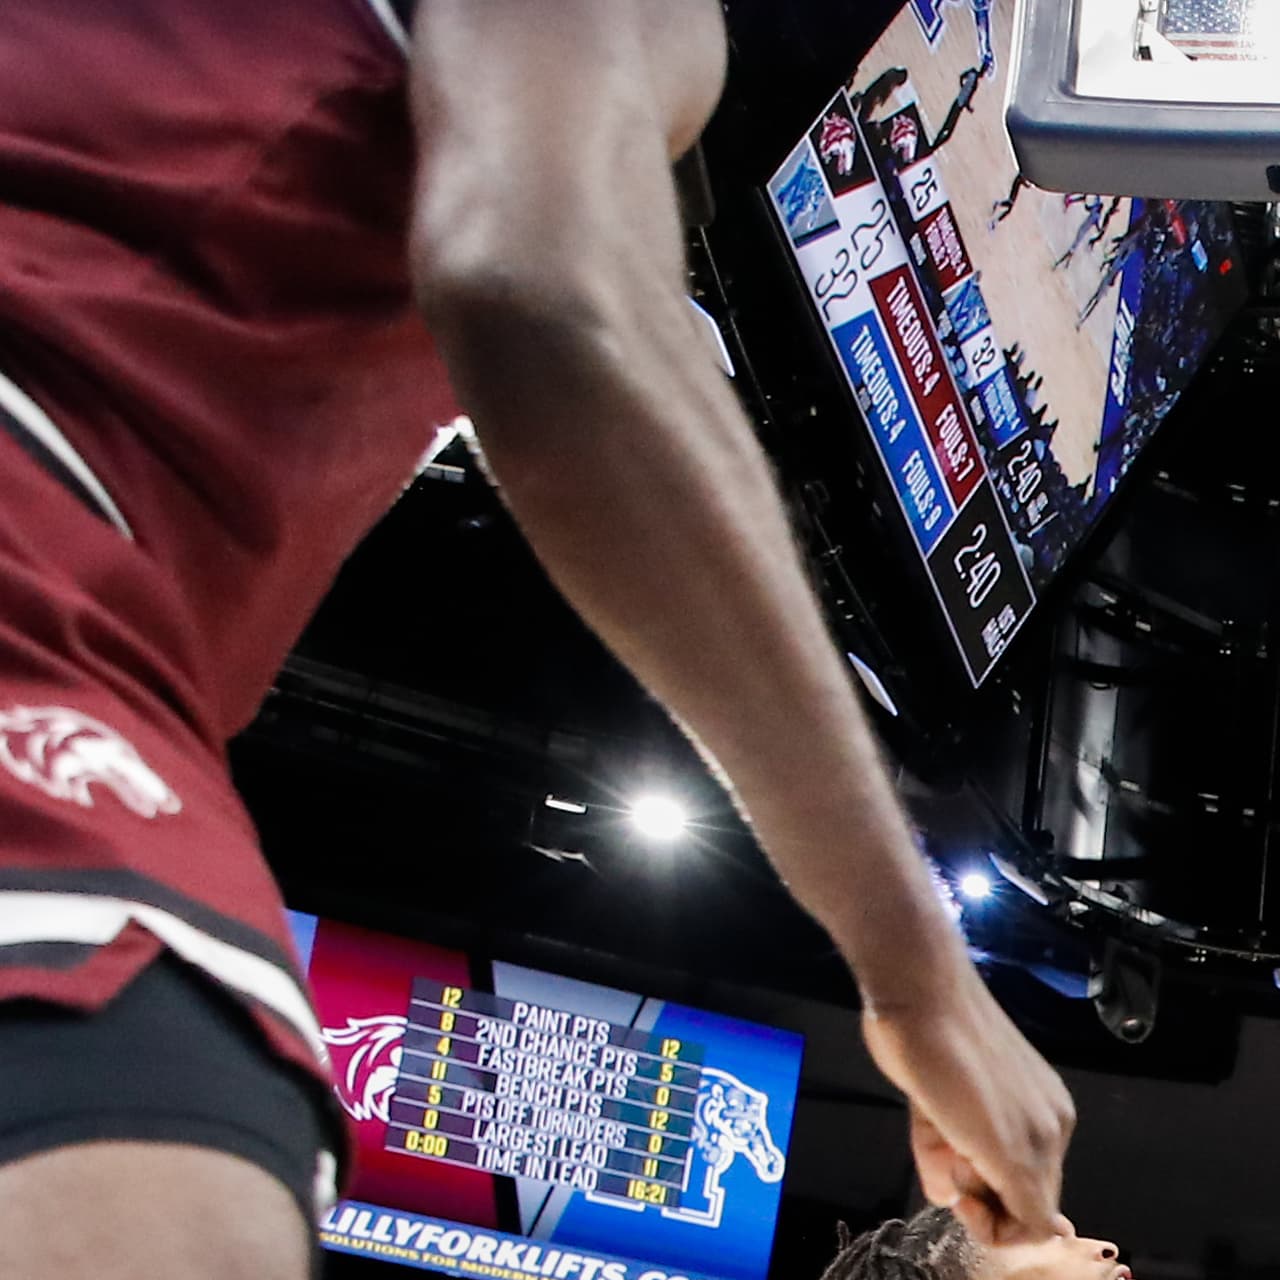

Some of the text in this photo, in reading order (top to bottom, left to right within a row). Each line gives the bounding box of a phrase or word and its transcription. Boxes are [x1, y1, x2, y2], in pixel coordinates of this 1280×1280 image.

[911, 168, 938, 212] 25
[851, 199, 896, 271] 25
[815, 248, 857, 322] 32
[972, 336, 996, 377] 32
[1007, 440, 1041, 503] 2:40
[954, 524, 1001, 608] 2:40
[443, 986, 681, 1060] 12 PAINT PTS 12
[475, 1019, 517, 1049] 2ND
[520, 1028, 598, 1068] CHANCE
[600, 1047, 638, 1077] PTS
[660, 1064, 673, 1083] 5
[431, 1061, 669, 1131] 11 BENCH PTS 12
[437, 1037, 670, 1106] 4 FASTBREAK PTS 0
[424, 1110, 659, 1179] 0 LARGEST LEAD 11
[428, 1085, 663, 1154] 5 PTS OFF TURNOVERS 0
[405, 1131, 668, 1204] 0:00 TIME IN LEAD 16:21
[422, 1252, 458, 1268] FOR
